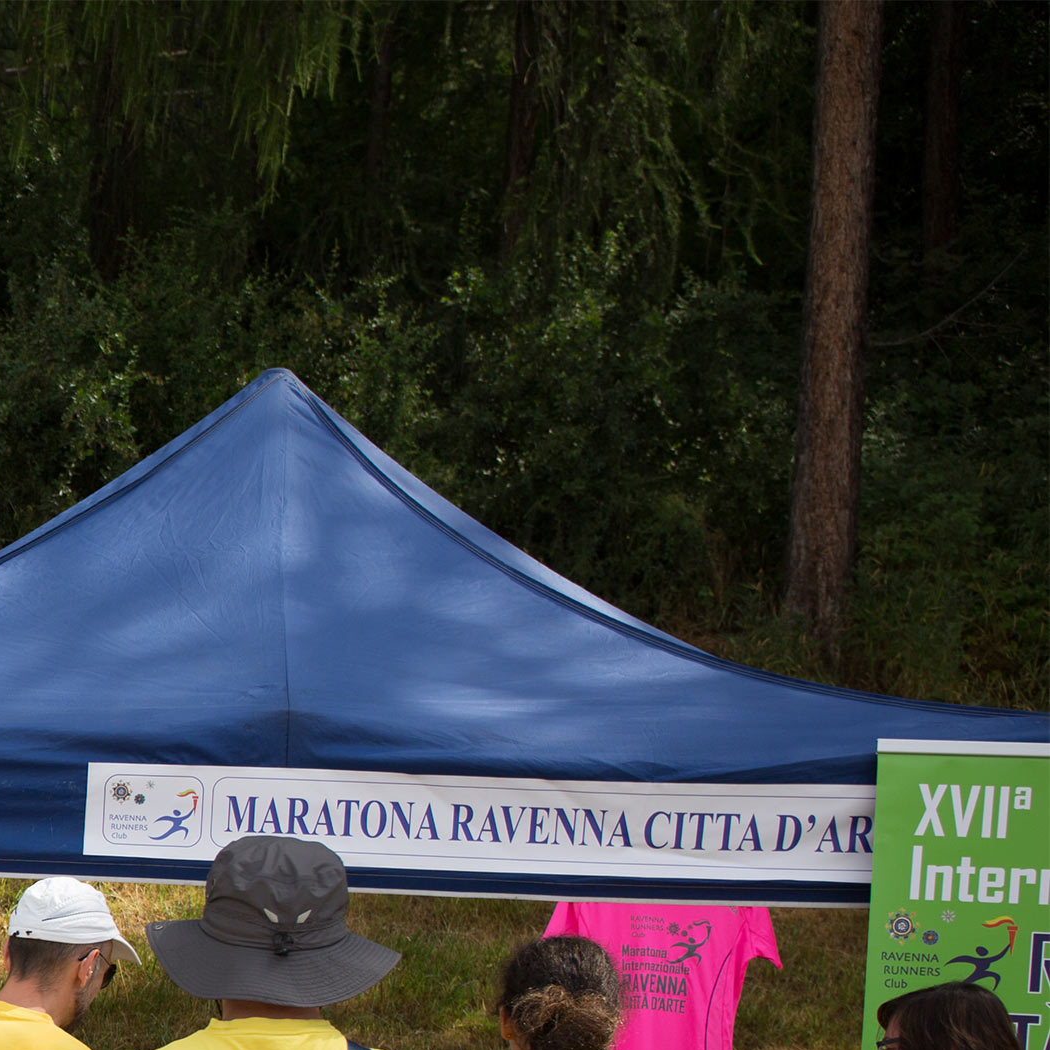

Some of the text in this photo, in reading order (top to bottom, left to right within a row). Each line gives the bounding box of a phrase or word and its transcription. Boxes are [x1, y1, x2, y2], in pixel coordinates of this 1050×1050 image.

[109, 813, 148, 822] RAVENNA
[224, 795, 441, 840] MARATONA
[450, 803, 633, 848] RAVENNA
[644, 811, 763, 852] CITTA
[111, 822, 149, 831] RUNNERS
[111, 832, 128, 840] Club
[622, 944, 667, 959] Maratona
[881, 951, 939, 963] RAVENNA
[622, 959, 690, 976] Internazionale
[883, 965, 941, 977] RUNNERS
[622, 974, 687, 997] RAVENNA
[884, 978, 909, 989] Club
[651, 996, 687, 1014] D'ARTE
